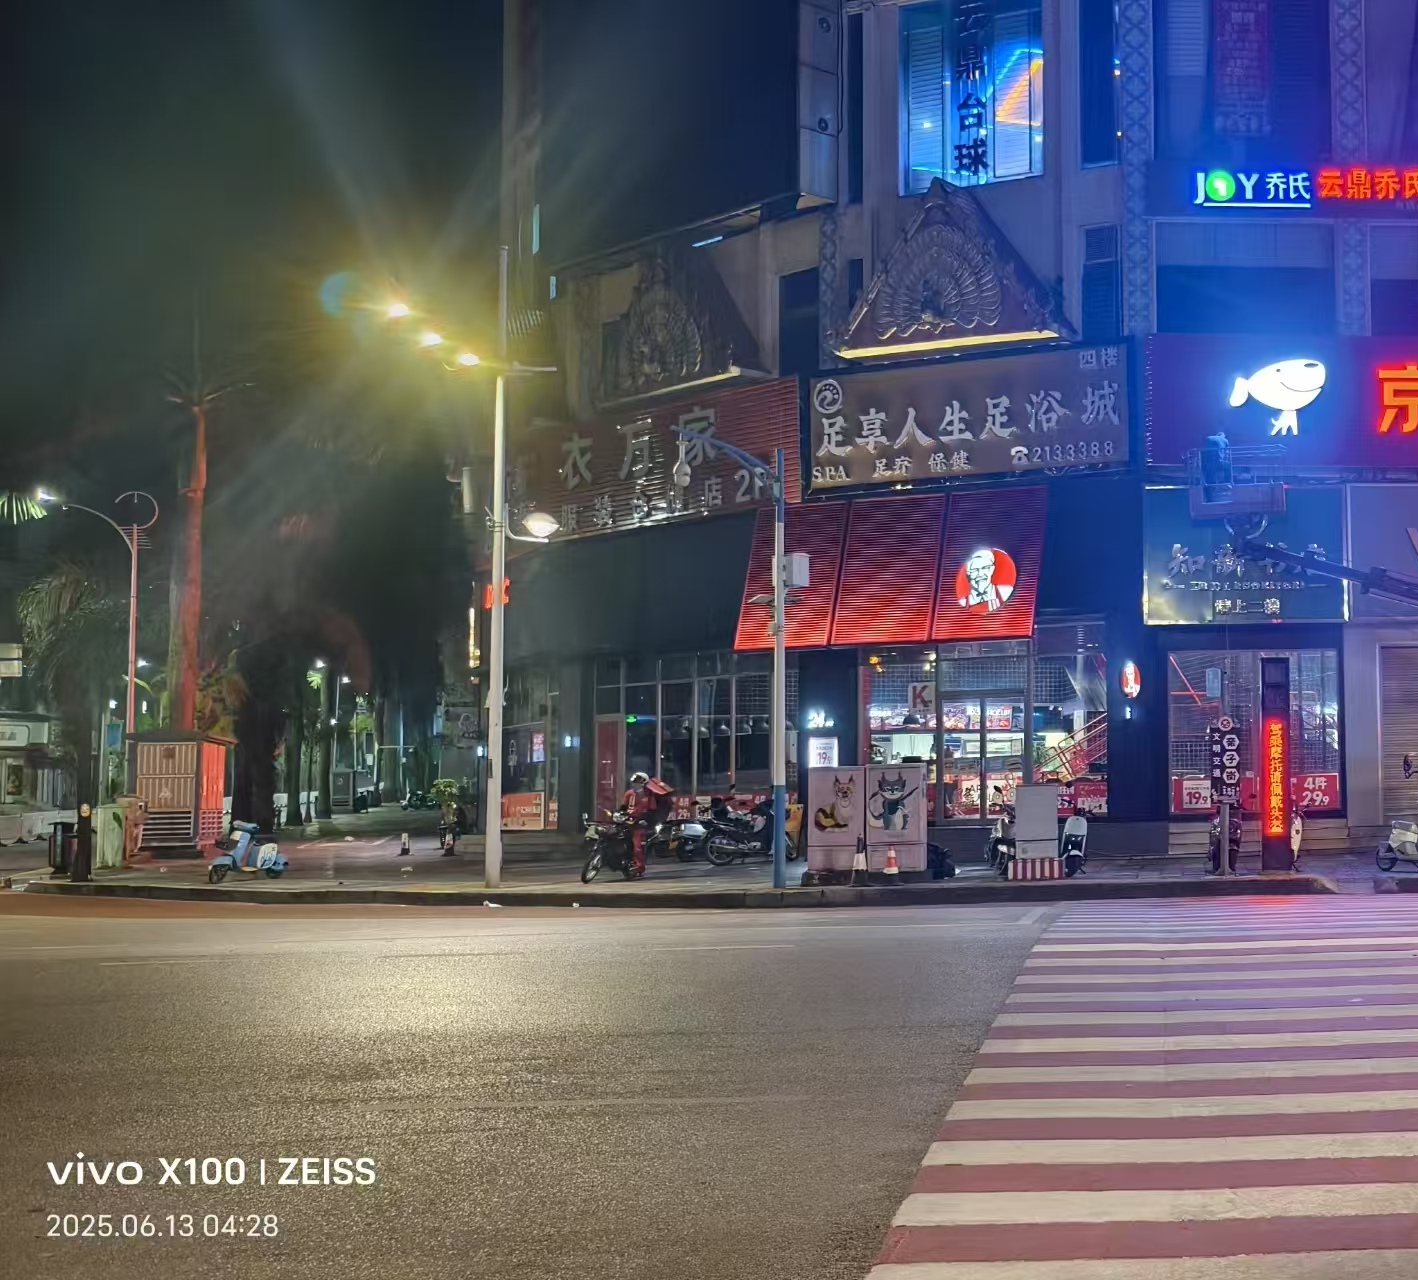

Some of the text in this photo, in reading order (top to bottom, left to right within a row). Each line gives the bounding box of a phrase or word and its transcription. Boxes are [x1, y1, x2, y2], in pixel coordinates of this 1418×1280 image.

[1194, 171, 1260, 204] JOY
[1265, 172, 1311, 200] 乔氏
[1079, 347, 1119, 369] 四楼
[815, 380, 1120, 457] 足享人生足浴城
[811, 441, 1114, 482] SPA 足疗 保健 2133388
[1213, 733, 1221, 778] 文明交通
[1303, 777, 1328, 790] 4件
